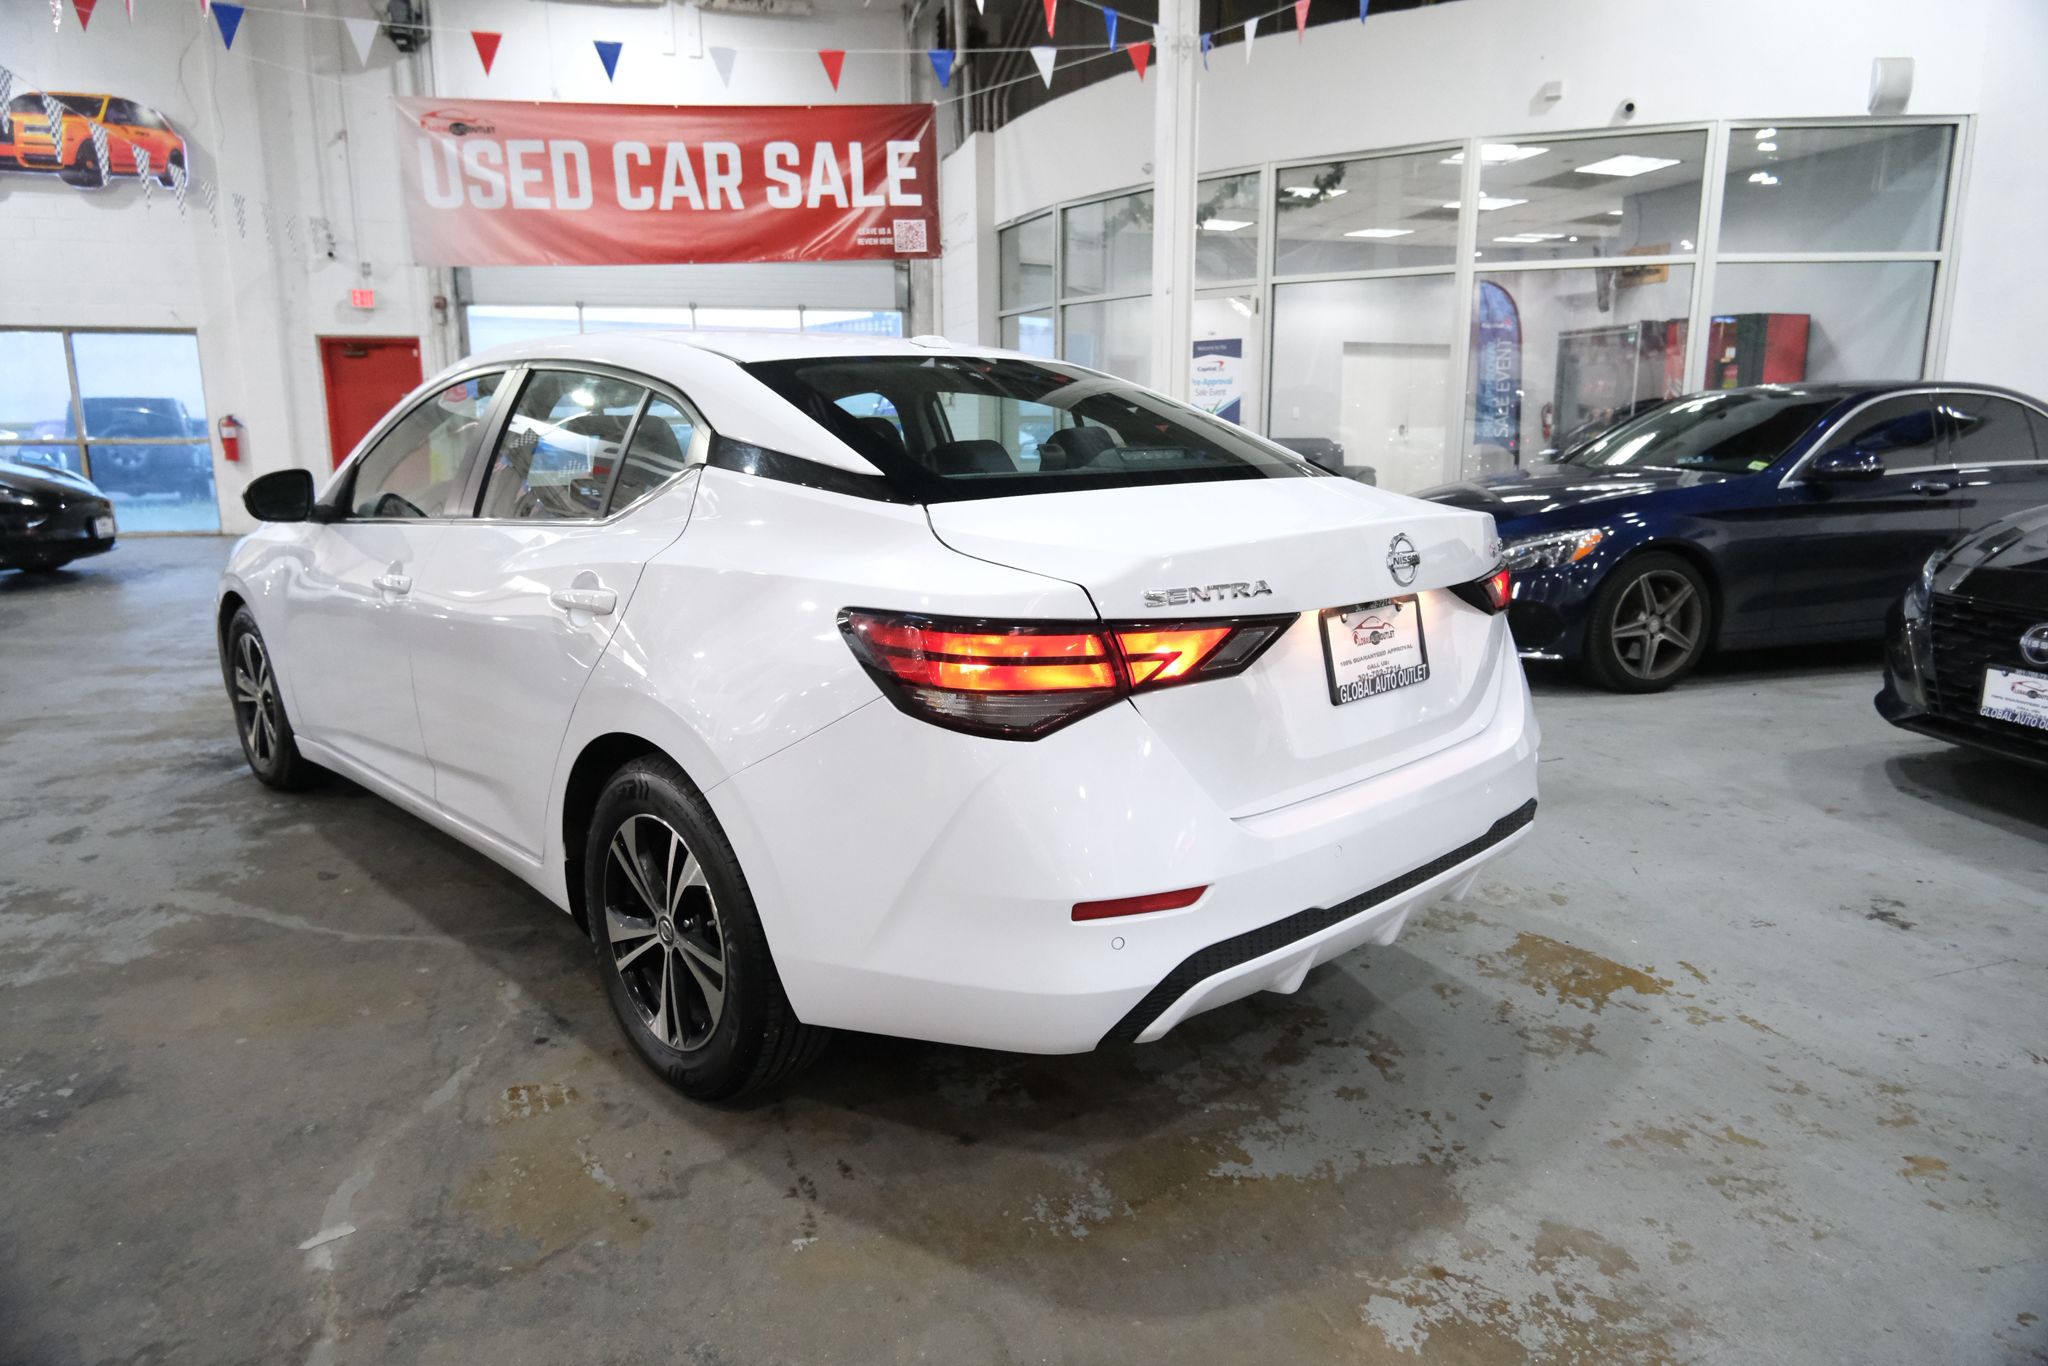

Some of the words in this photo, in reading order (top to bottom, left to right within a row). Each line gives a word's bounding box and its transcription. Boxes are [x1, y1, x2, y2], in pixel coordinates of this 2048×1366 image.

[418, 138, 593, 210] USED
[613, 140, 744, 211] CAR
[764, 139, 922, 209] SALE
[1495, 338, 1512, 393] EVENT
[1494, 396, 1510, 438] SALE
[1144, 579, 1273, 608] SENTRA
[1340, 681, 1375, 703] GLOBAL
[1375, 673, 1397, 693] AUTO
[1398, 663, 1427, 686] OUTLET
[1980, 706, 2013, 722] GLOBAL
[2013, 713, 2038, 728] AUTO
